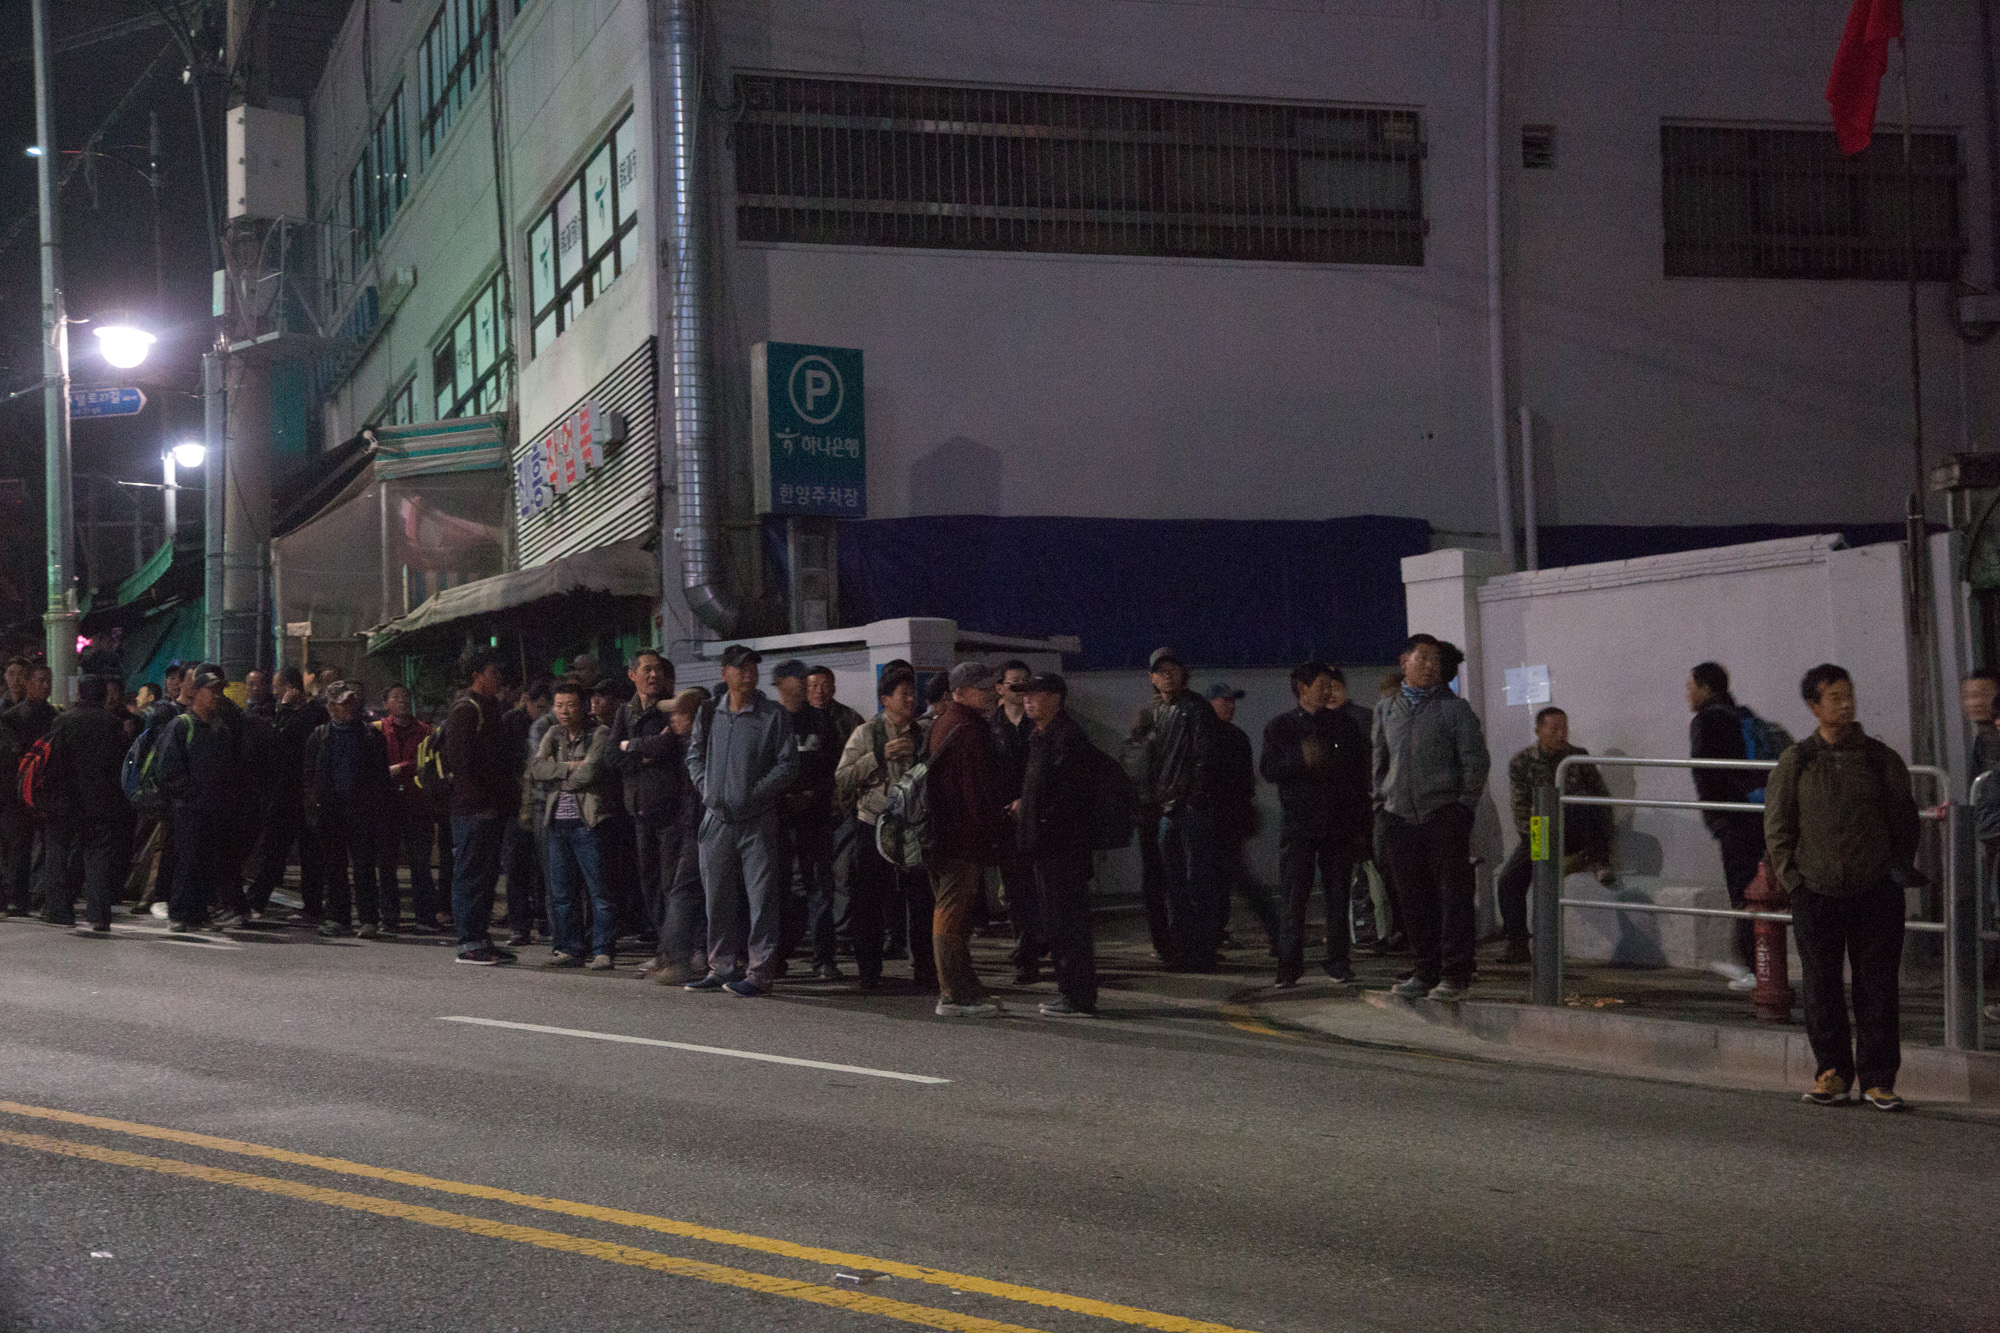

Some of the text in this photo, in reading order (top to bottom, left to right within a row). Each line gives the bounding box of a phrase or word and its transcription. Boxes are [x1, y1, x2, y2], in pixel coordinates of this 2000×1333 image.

[805, 369, 832, 411] P
[801, 435, 860, 459] 하나은행
[779, 483, 859, 508] 한양주차장
